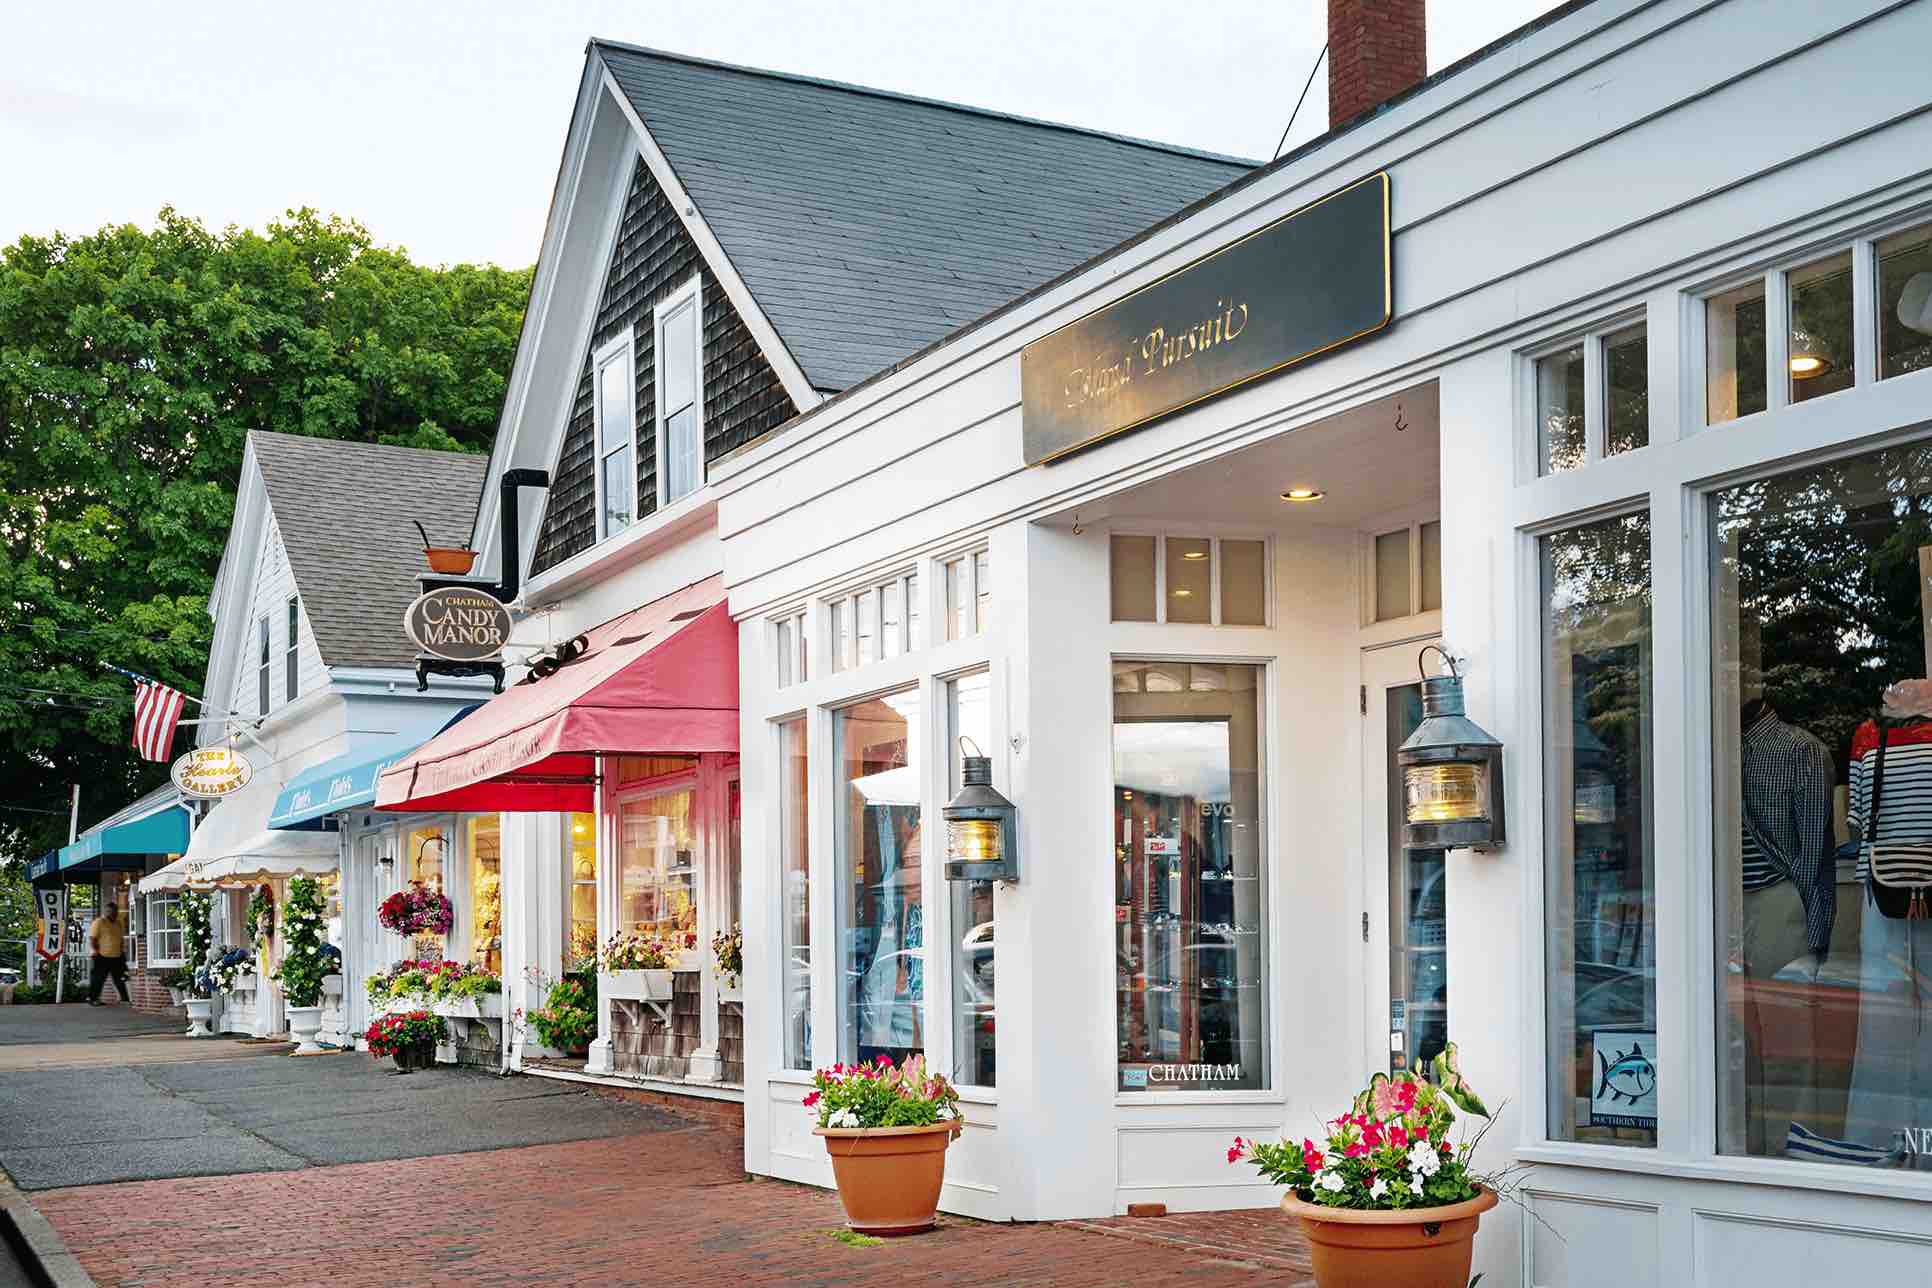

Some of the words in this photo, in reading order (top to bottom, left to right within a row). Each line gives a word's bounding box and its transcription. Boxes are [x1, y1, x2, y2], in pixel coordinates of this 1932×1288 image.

[1141, 296, 1248, 376] Pursuit
[422, 598, 501, 627] CANDY
[447, 597, 496, 608] CHATHAM
[424, 623, 502, 645] MANOR
[45, 892, 59, 950] OPEN
[1148, 1063, 1241, 1082] CHATHAM
